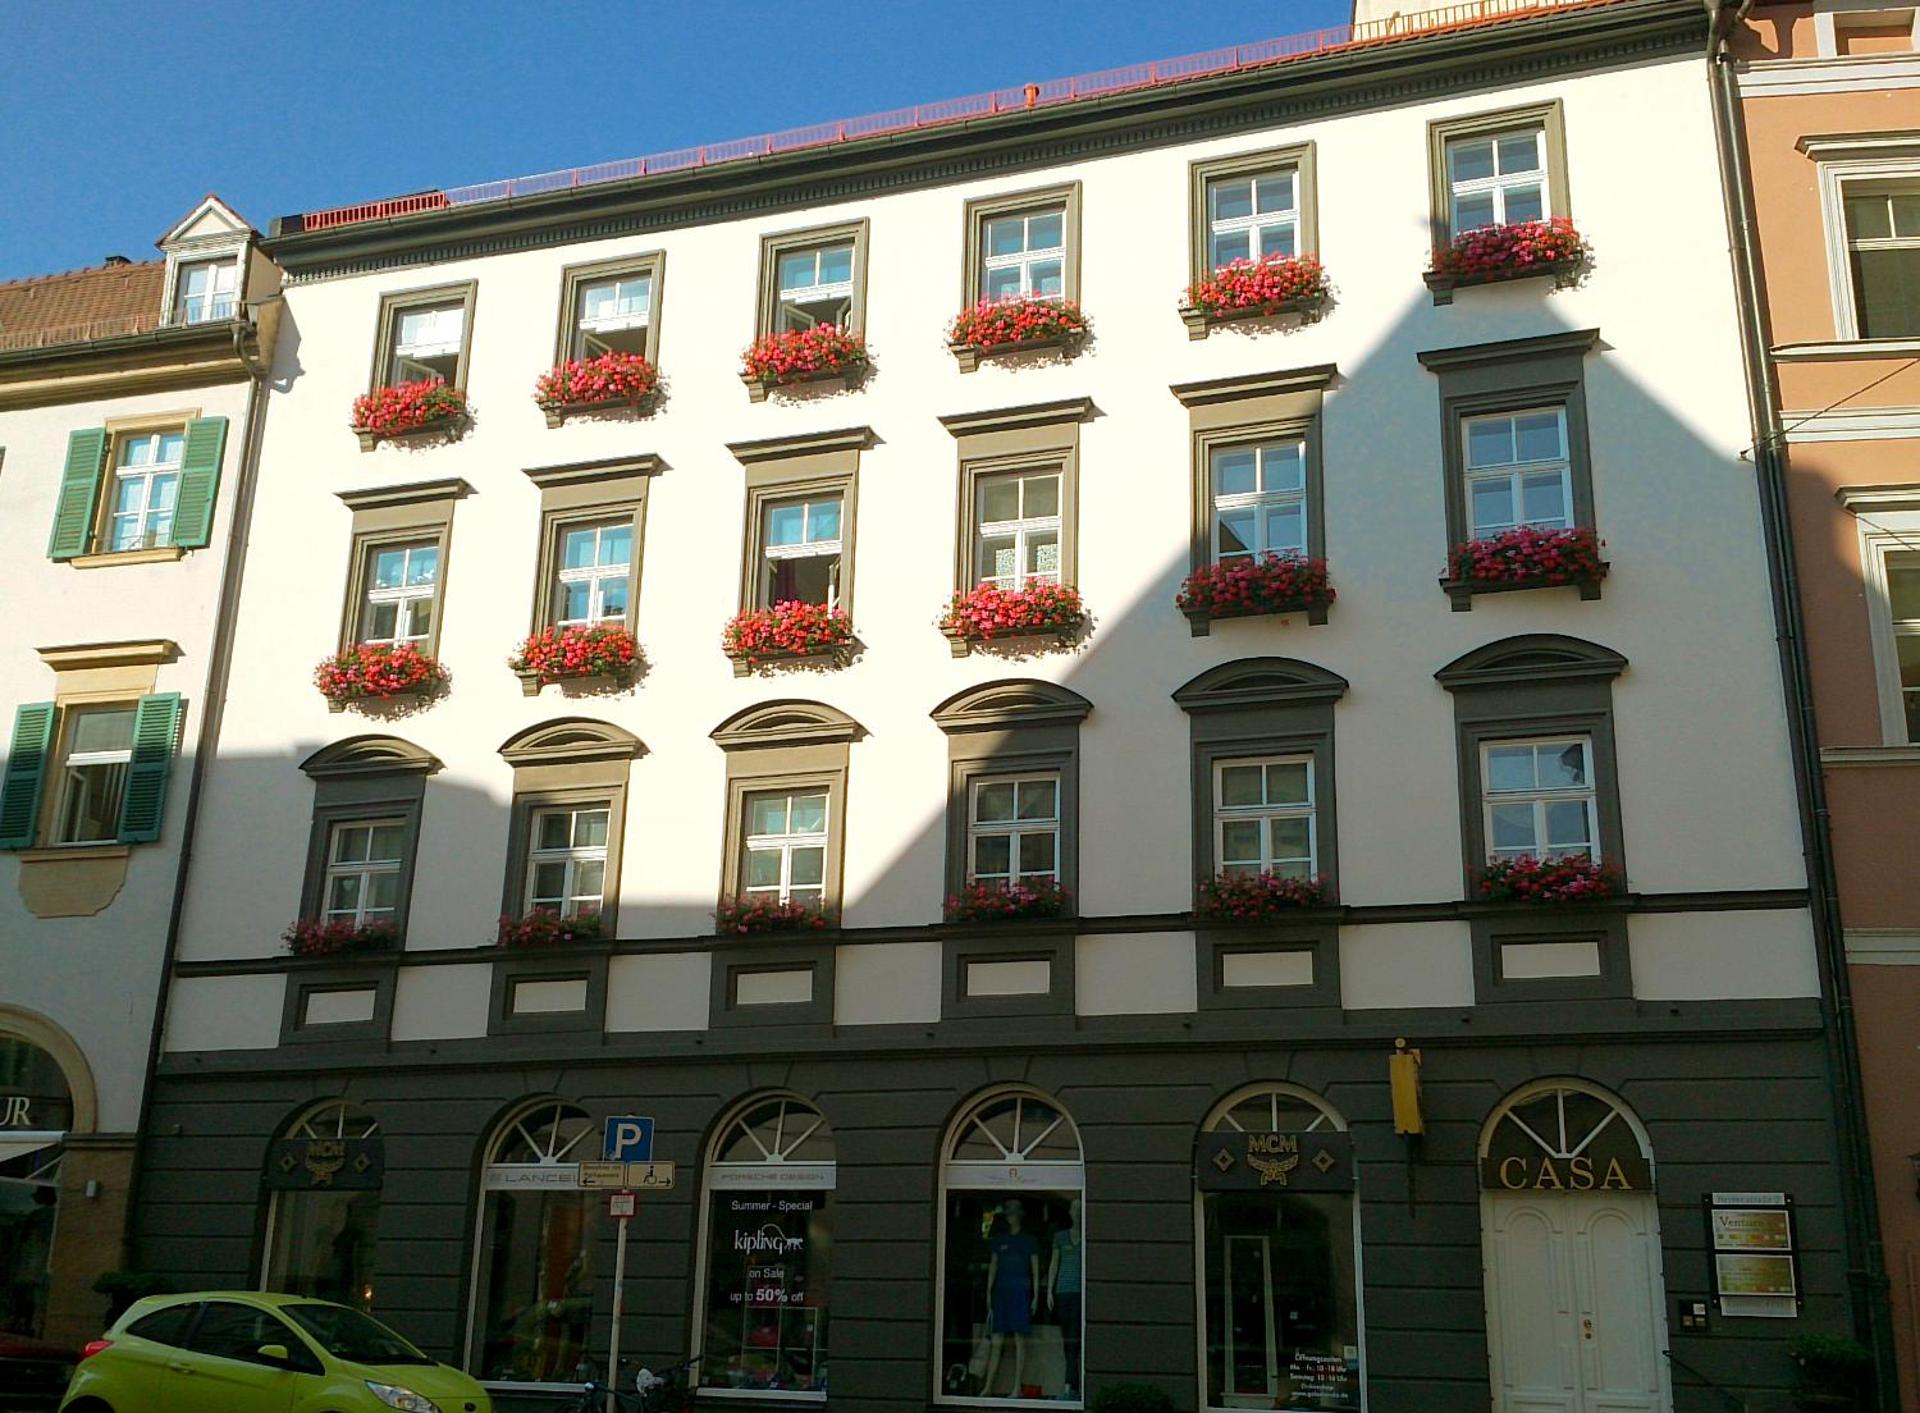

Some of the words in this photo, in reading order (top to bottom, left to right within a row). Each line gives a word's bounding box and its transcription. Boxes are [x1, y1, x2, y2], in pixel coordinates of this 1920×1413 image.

[615, 1123, 642, 1160] P
[1247, 1134, 1298, 1153] MCM
[1499, 1156, 1635, 1190] CASA
[731, 1200, 771, 1211] Summer
[778, 1200, 813, 1213] Special
[734, 1229, 783, 1255] kipling
[749, 1270, 761, 1279] on
[763, 1268, 785, 1279] Sale
[730, 1292, 742, 1304] up
[744, 1291, 754, 1302] to
[756, 1288, 789, 1303] 50%
[790, 1291, 804, 1302] off
